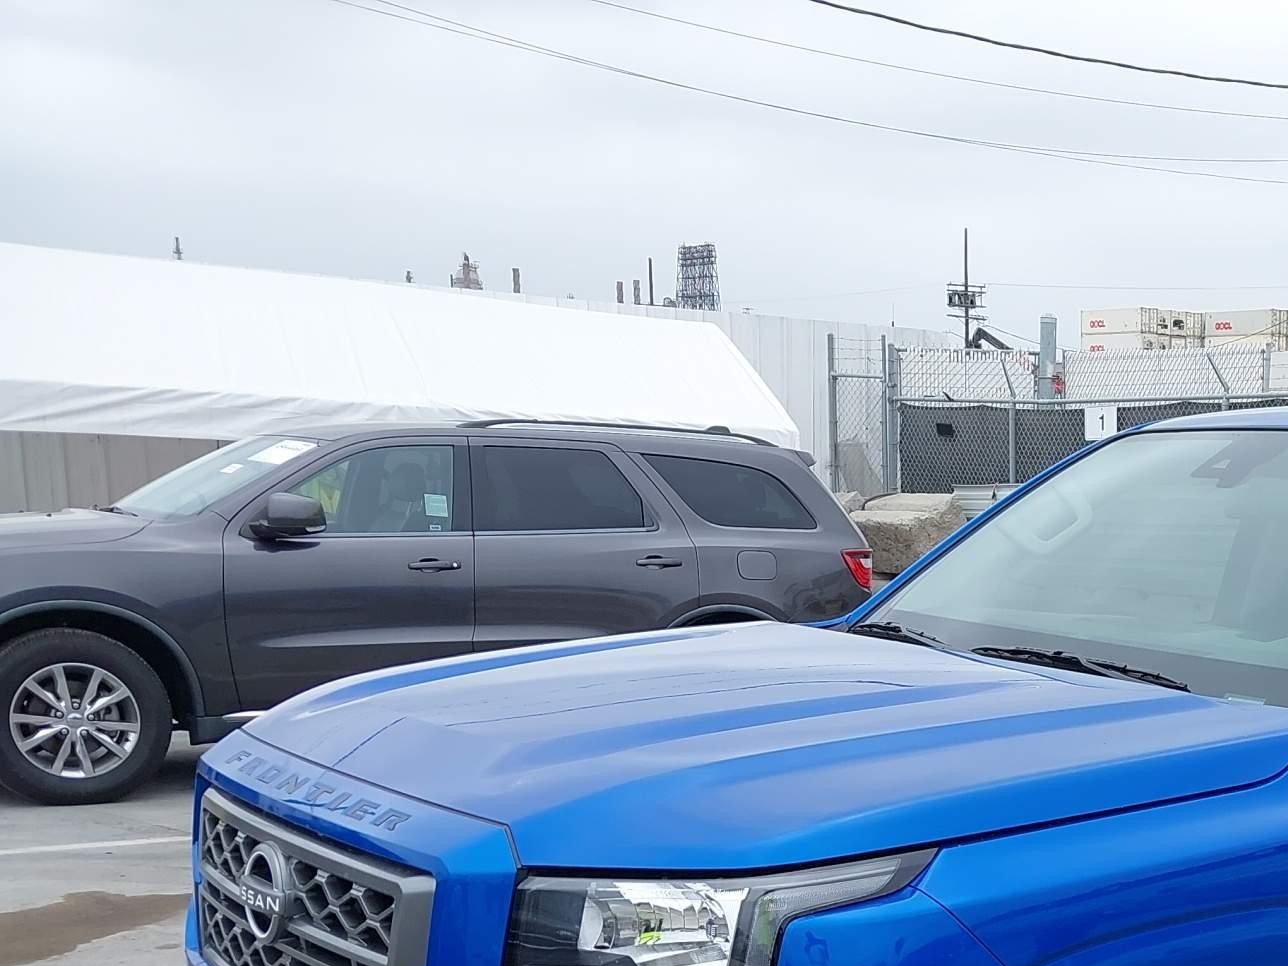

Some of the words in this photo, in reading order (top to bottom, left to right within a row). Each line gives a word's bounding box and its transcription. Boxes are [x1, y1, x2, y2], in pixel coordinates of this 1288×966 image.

[1215, 321, 1233, 331] OOCL
[1099, 413, 1105, 432] 1
[224, 750, 413, 832] FRONTIER
[241, 886, 280, 912] SSAN
